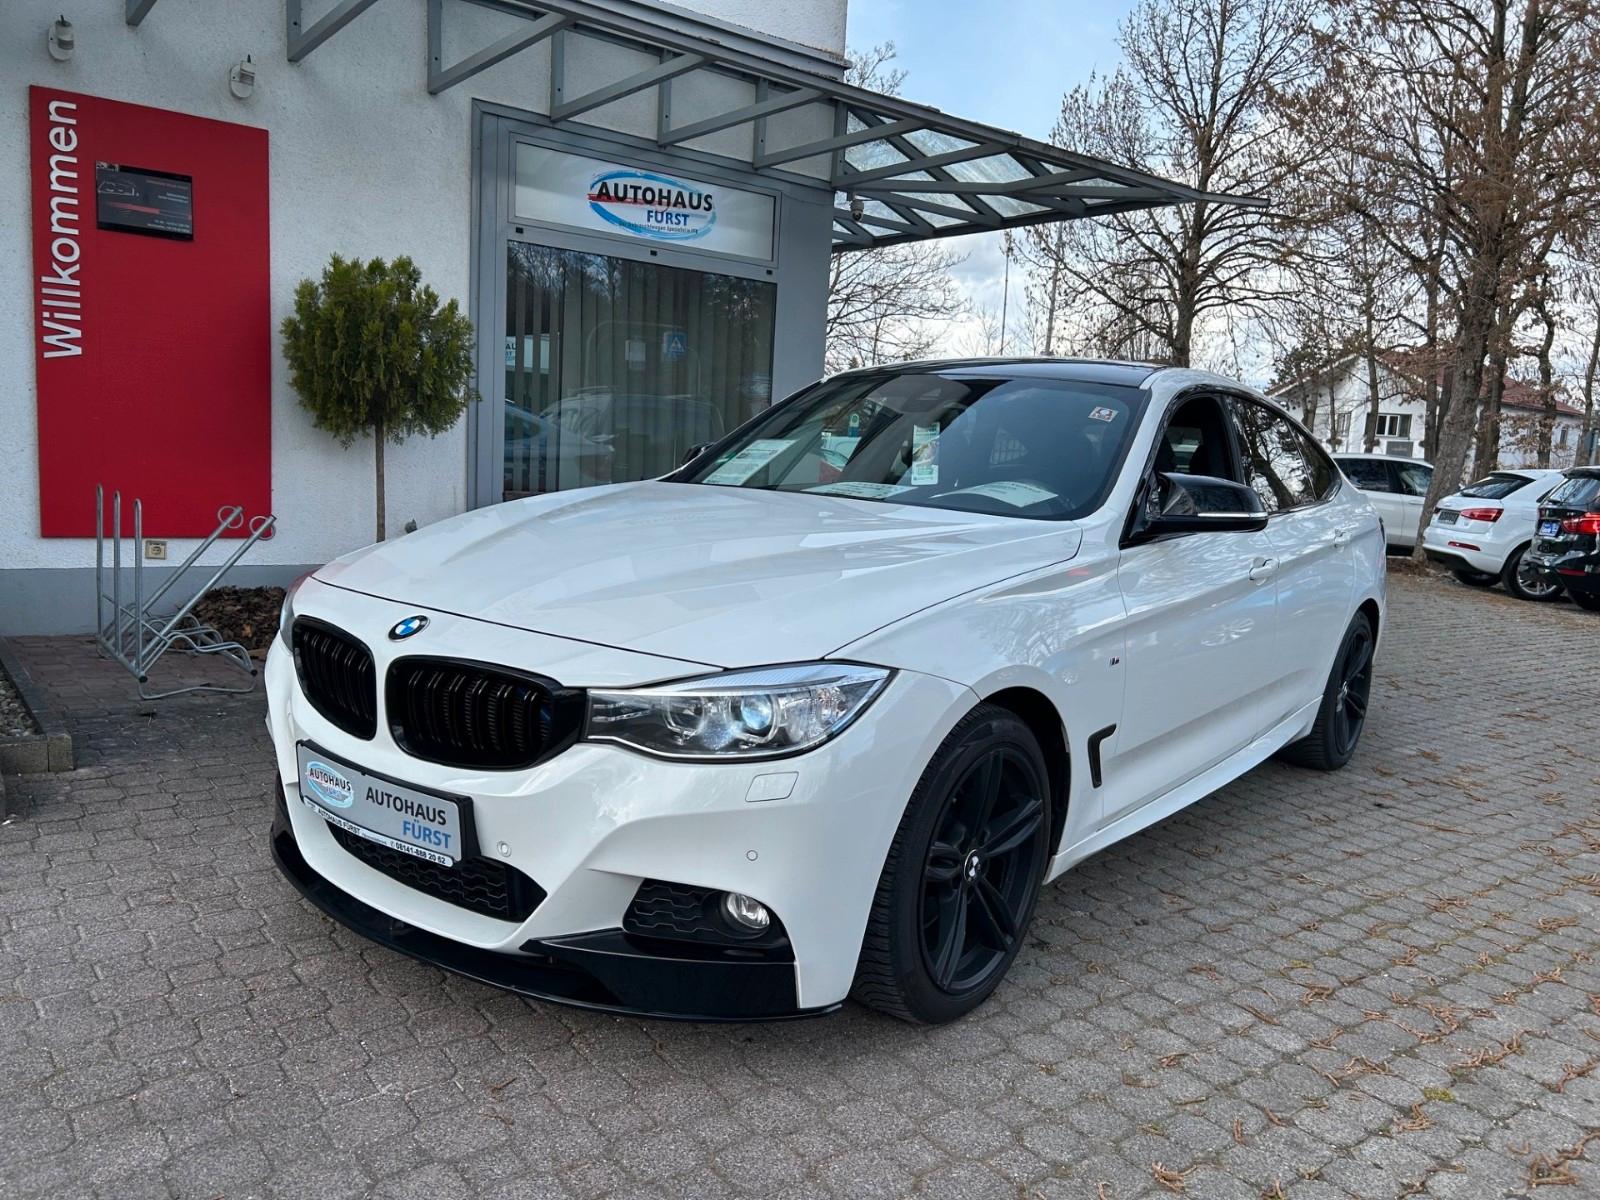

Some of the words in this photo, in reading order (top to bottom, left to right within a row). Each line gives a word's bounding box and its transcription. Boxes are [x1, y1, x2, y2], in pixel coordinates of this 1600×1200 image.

[597, 181, 713, 212] AUTOHAUS
[41, 100, 82, 359] Willkommen
[309, 767, 352, 792] AUTOHAUS
[366, 786, 447, 826] AUTOHAUS
[402, 819, 452, 849] FÜRST
